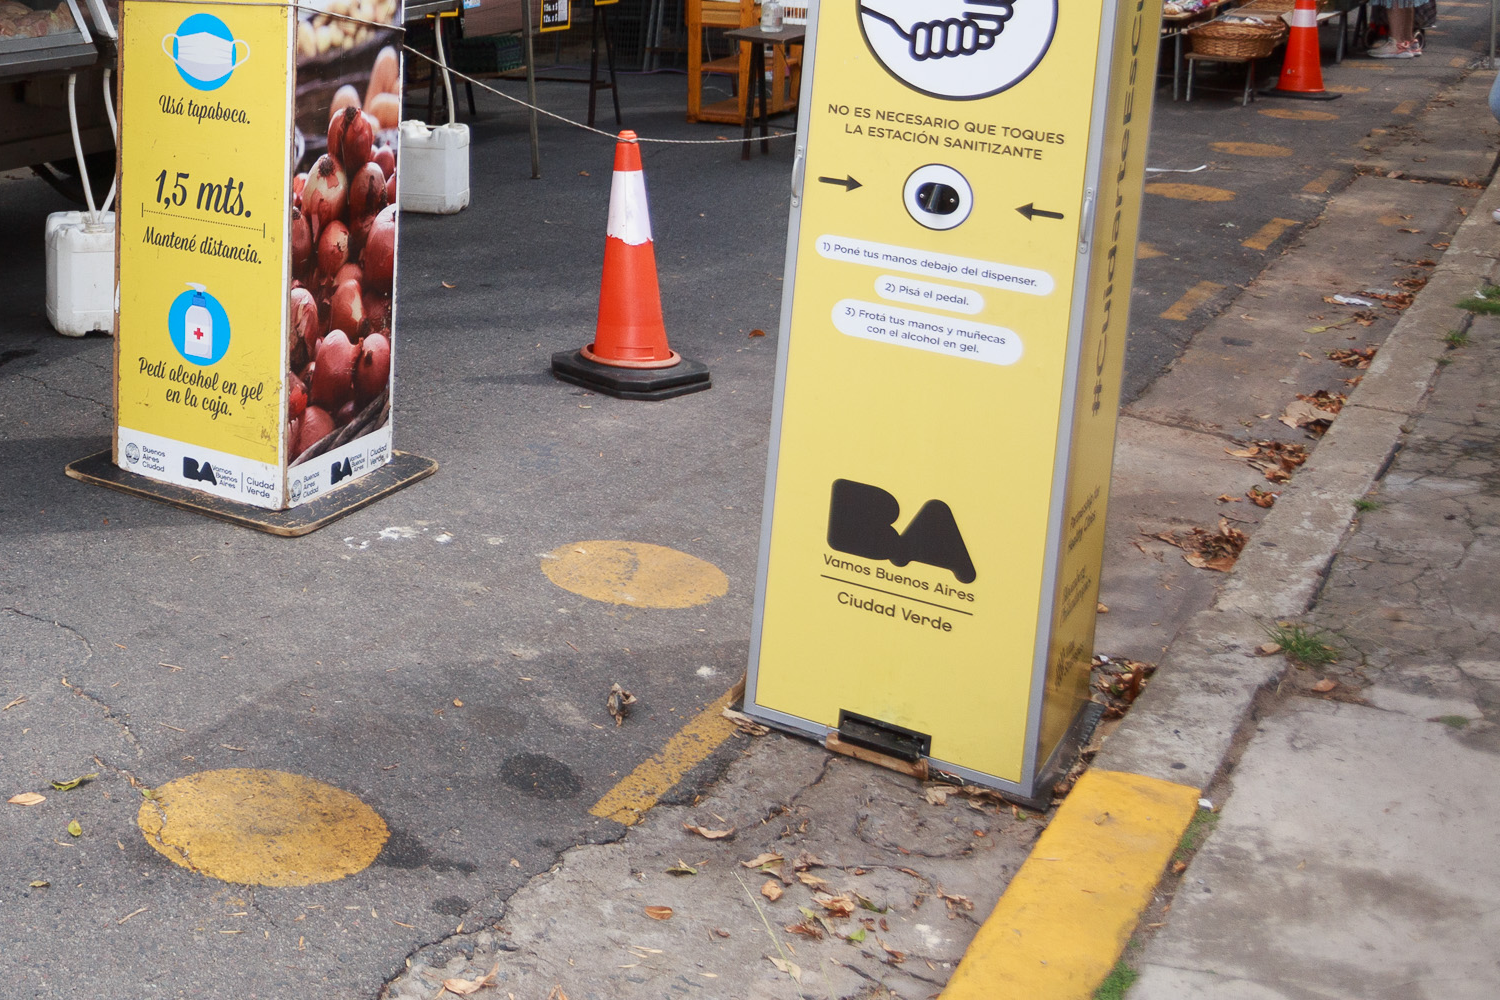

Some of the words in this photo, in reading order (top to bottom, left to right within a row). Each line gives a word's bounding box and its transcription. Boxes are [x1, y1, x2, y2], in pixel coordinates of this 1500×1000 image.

[158, 94, 185, 116] Usá
[188, 99, 251, 125] tapaboca.
[827, 103, 850, 116] NO
[853, 106, 871, 120] ES
[875, 109, 960, 131] NECESARIO
[963, 121, 997, 137] QUE
[1001, 126, 1065, 145] TOQUES
[844, 123, 863, 136] LA
[867, 126, 940, 147] ESTACIÓN
[943, 135, 1043, 161] SANITIZANTE
[155, 169, 190, 210] 1,5
[197, 177, 252, 218] mts.
[142, 225, 197, 253] Mantené
[199, 237, 263, 265] distancia.
[822, 241, 831, 252] 1)
[833, 243, 860, 257] Poné
[863, 248, 879, 260] tus
[881, 252, 918, 267] manos
[920, 257, 958, 276] debajo
[961, 264, 979, 277] del
[981, 267, 1038, 289] dispenser.
[884, 282, 896, 294] 2)
[898, 284, 921, 298] Pisá
[923, 288, 933, 299] el
[935, 290, 970, 307] pedal.
[844, 306, 856, 318] 3)
[858, 308, 887, 323] Frotá
[889, 315, 905, 327] tus
[908, 319, 944, 334] manos
[946, 326, 954, 337] y
[956, 325, 1007, 346] muñecas
[866, 324, 886, 336] con
[888, 328, 899, 338] el
[901, 331, 941, 347] alcohol
[943, 338, 957, 349] en
[959, 341, 980, 356] gel.
[138, 356, 167, 380] Pedí
[168, 364, 219, 392] alcohol
[222, 379, 238, 396] en
[240, 378, 264, 405] gel
[165, 388, 182, 404] en
[184, 388, 198, 407] la
[201, 393, 233, 420] caja.
[142, 445, 166, 457] Buenos
[142, 454, 160, 463] Aires
[350, 453, 362, 462] Vamos
[370, 443, 388, 457] Ciudad
[370, 454, 385, 465] Verde
[142, 461, 165, 472] Ciudad
[183, 456, 217, 486] BA
[211, 465, 232, 475] Vamos
[330, 457, 353, 485] BA
[351, 458, 366, 468] Buenos
[215, 472, 238, 483] Buenos
[219, 480, 236, 489] Aires
[246, 477, 275, 491] Ciudad
[303, 471, 320, 483] Buenos
[303, 480, 316, 490] Aires
[246, 486, 270, 499] Verde
[303, 486, 319, 498] Ciudad
[826, 478, 977, 584] BA
[823, 552, 872, 576] Vamos
[875, 566, 930, 592] Buenos
[933, 581, 976, 603] Aires
[836, 591, 896, 618] Ciudad
[901, 606, 953, 633] Verde
